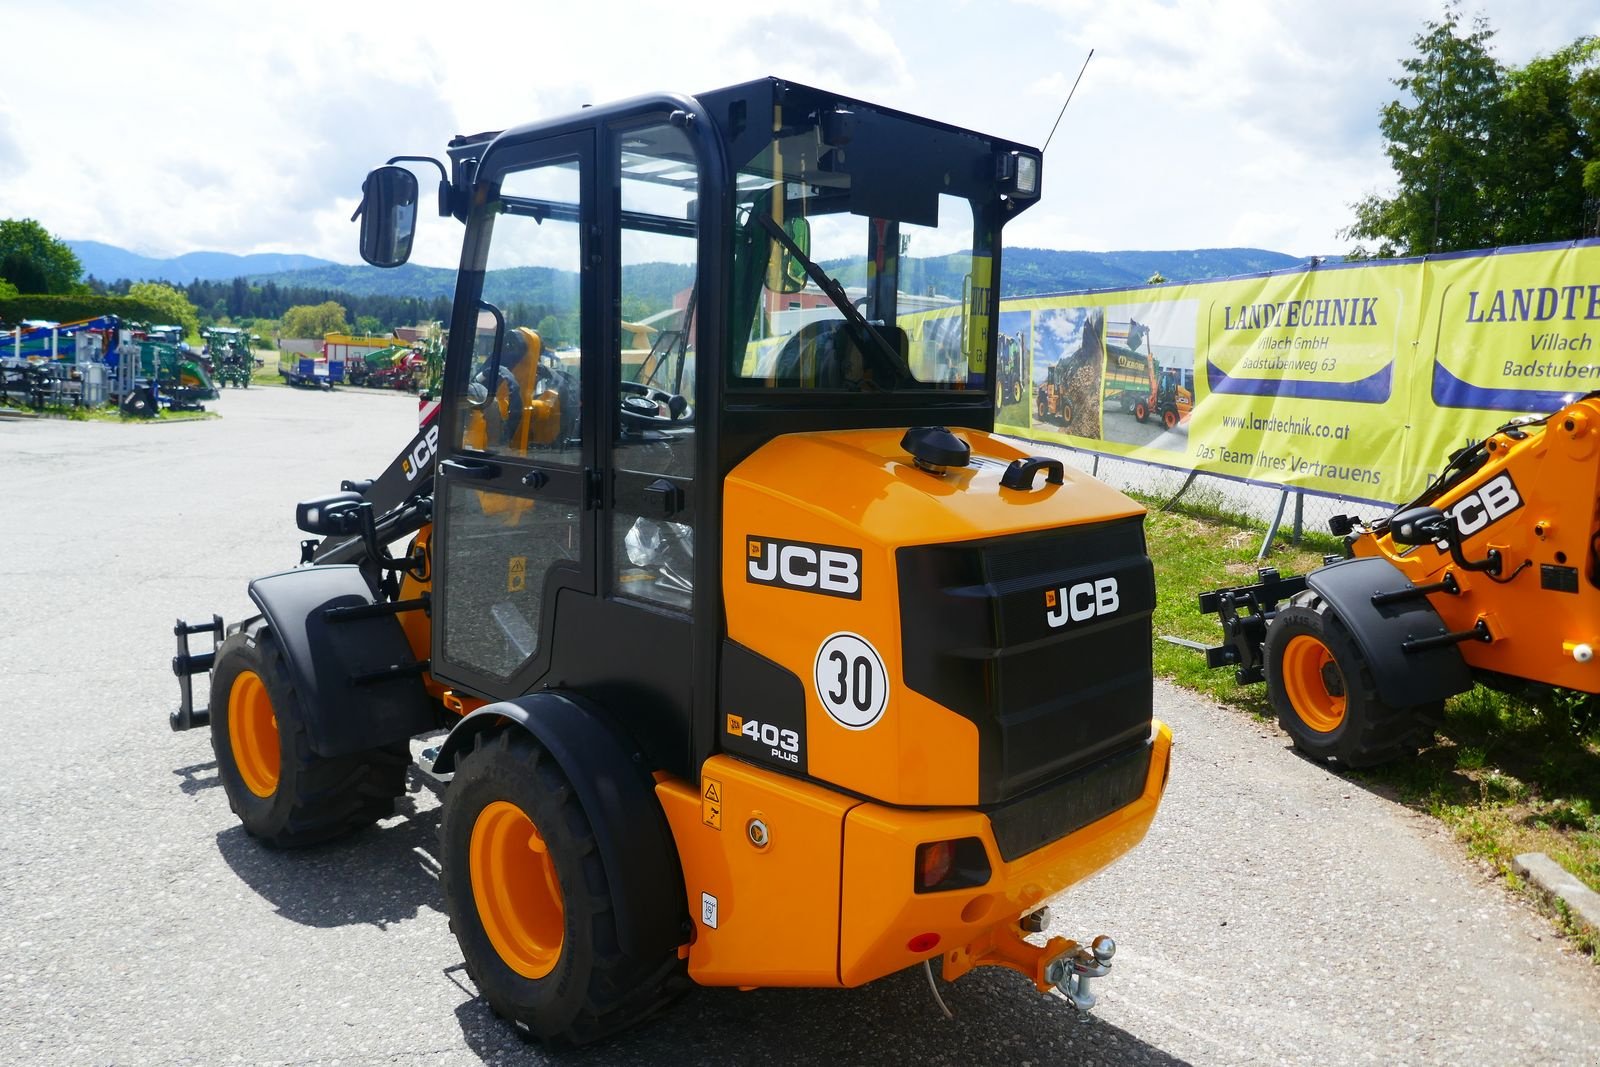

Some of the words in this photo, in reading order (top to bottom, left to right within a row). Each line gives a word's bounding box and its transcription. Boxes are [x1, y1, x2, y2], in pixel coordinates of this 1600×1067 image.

[1224, 297, 1378, 331] LANDTECHNIK
[1258, 336, 1292, 350] Villach
[1294, 336, 1329, 350] GmbH
[1530, 332, 1592, 351] Villach
[1242, 356, 1317, 374] Badstubenweg
[1321, 357, 1336, 371] 63
[1502, 360, 1600, 379] Badstuben
[1222, 412, 1350, 440] www.landtechnik.co.at
[1196, 443, 1215, 459] Das
[1219, 446, 1254, 465] Team
[1256, 450, 1286, 470] Ihres
[1290, 455, 1381, 485] Vertrauens
[749, 543, 859, 594] JCB
[1047, 577, 1120, 628] JCB
[828, 650, 873, 712] 30
[742, 720, 799, 753] 403
[771, 748, 799, 763] PLUS
